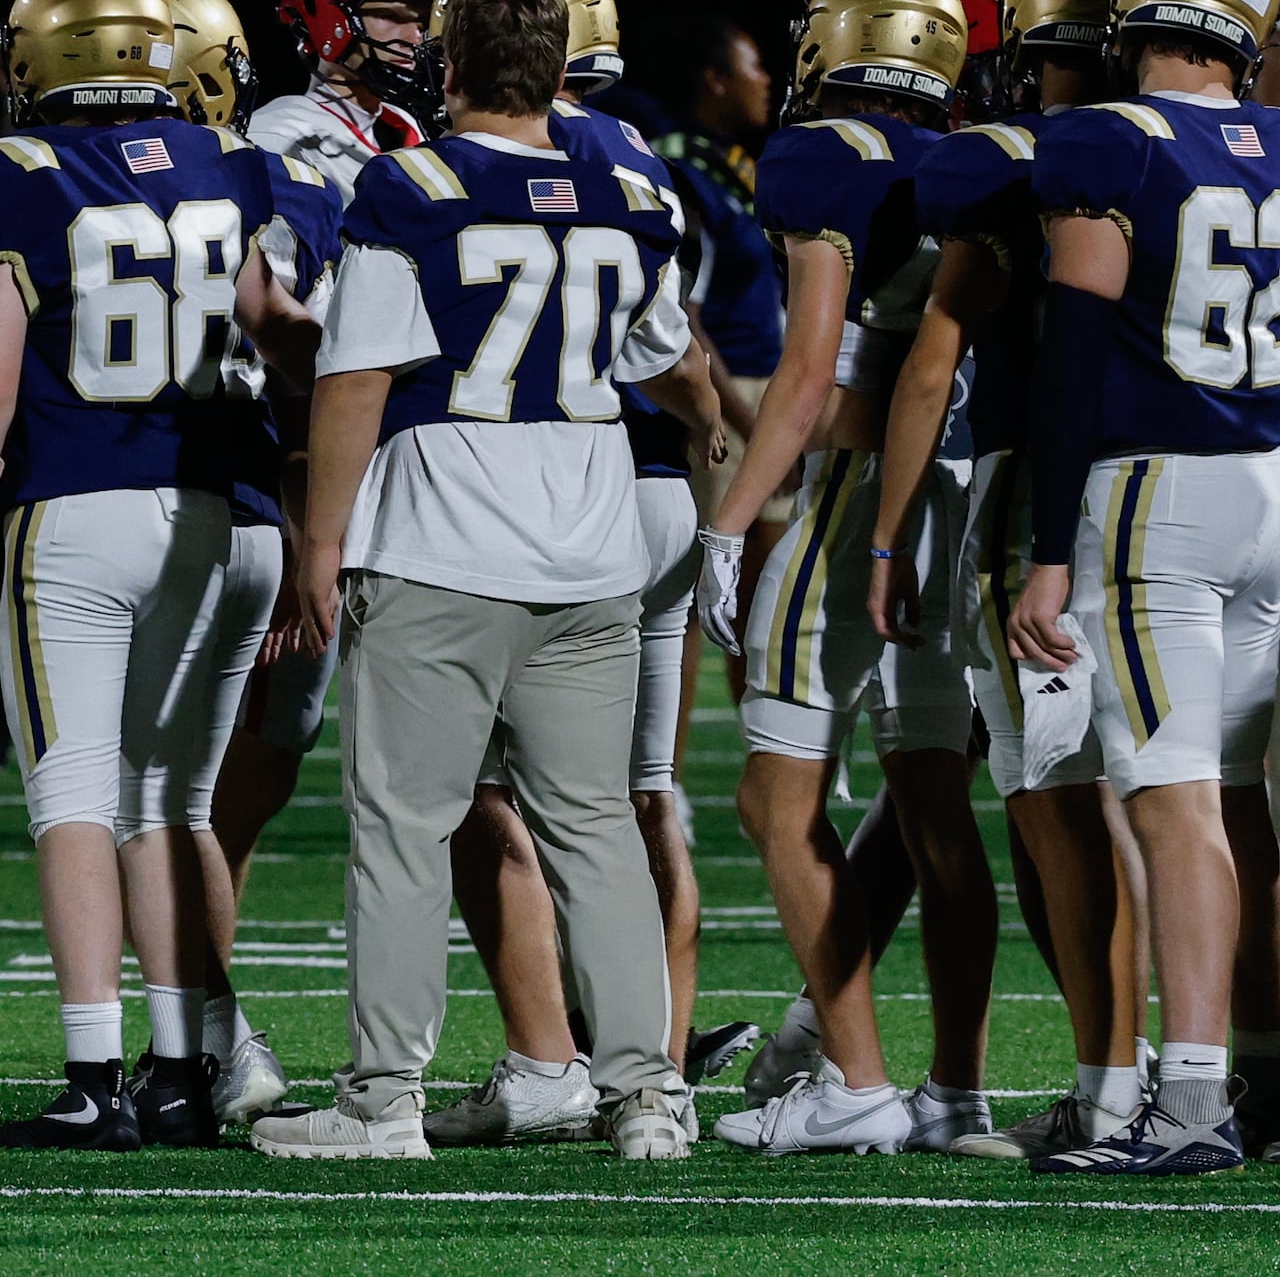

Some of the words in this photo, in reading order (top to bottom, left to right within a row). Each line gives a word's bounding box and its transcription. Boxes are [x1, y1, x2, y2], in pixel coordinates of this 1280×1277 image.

[1154, 5, 1205, 27] DOMINI
[862, 67, 912, 89] DOMINI
[72, 90, 119, 105] DOMINI
[66, 198, 262, 402] 68
[446, 223, 646, 422] 70
